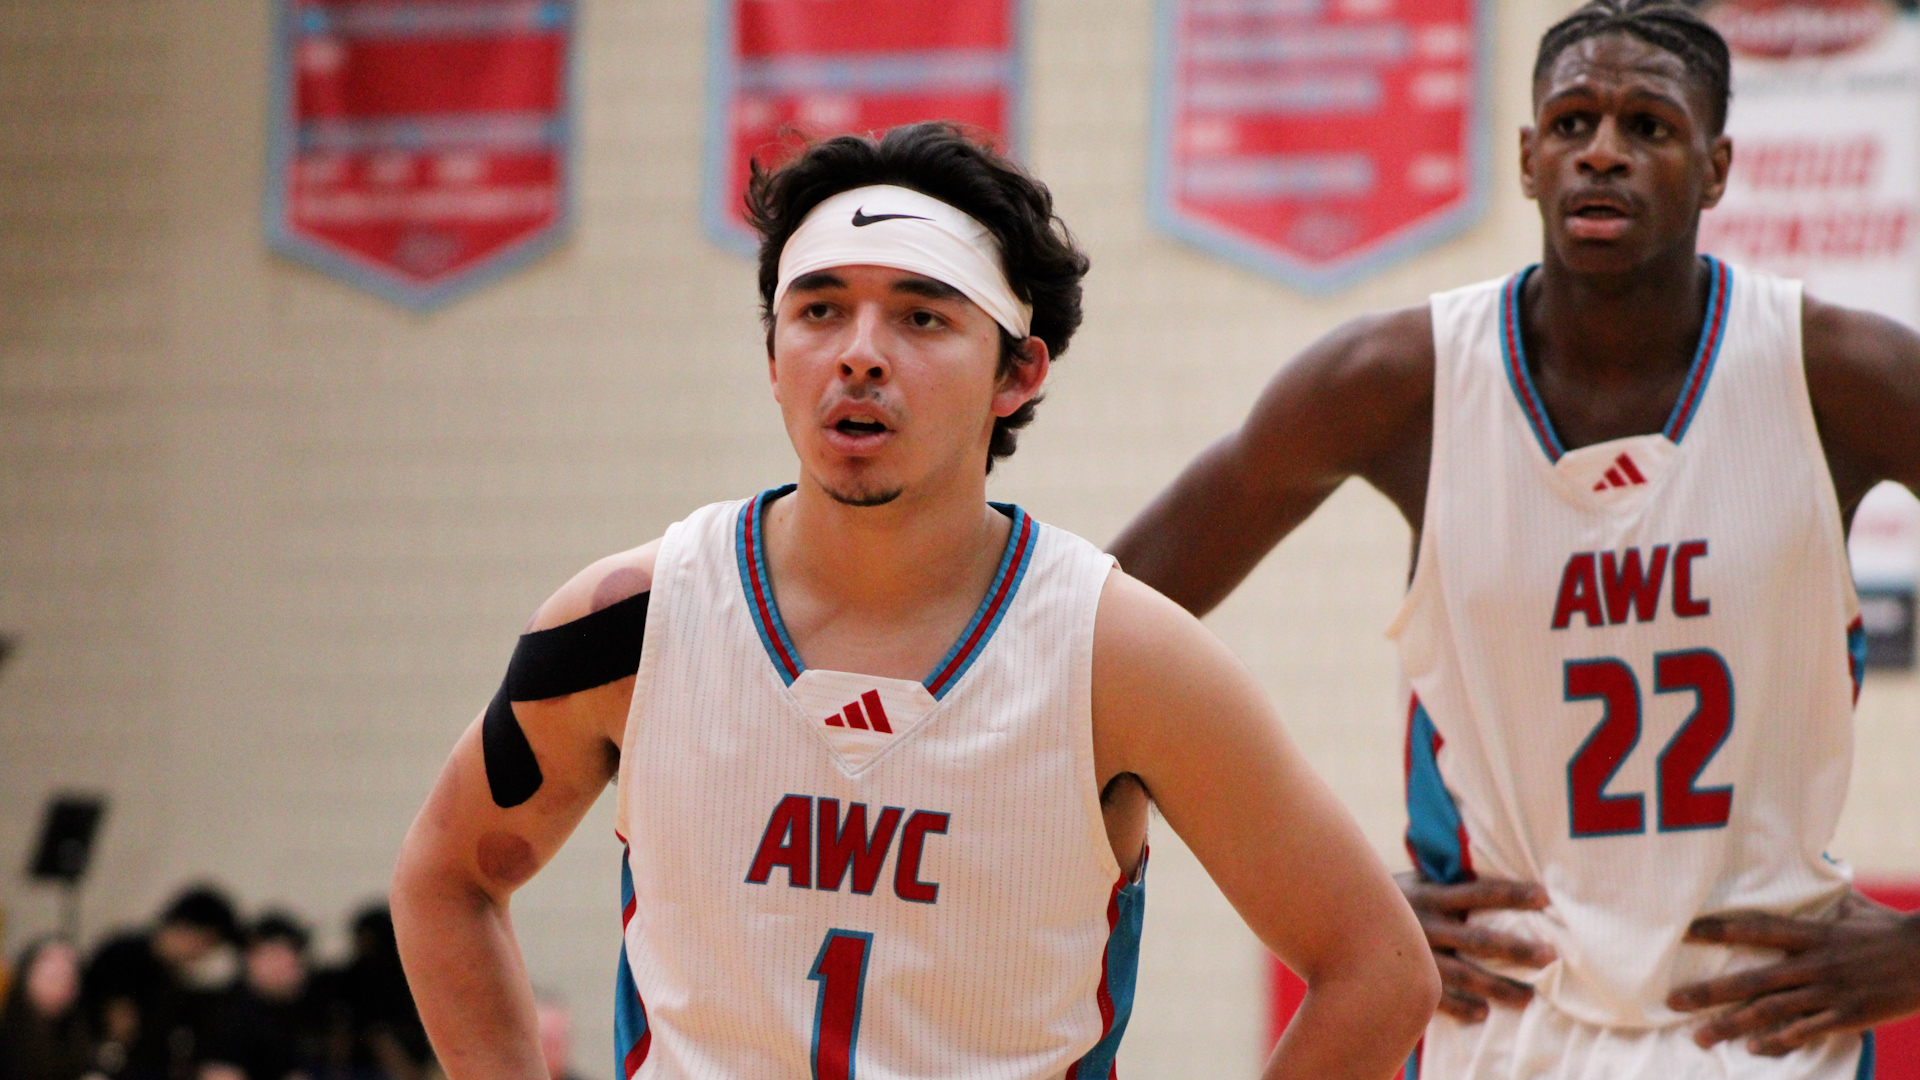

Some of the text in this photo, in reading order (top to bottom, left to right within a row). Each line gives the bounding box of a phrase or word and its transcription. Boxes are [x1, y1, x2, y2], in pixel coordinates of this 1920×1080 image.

[1551, 539, 1710, 630] AWC
[1563, 647, 1735, 839] 22
[745, 794, 950, 904] AWC
[807, 928, 874, 1080] 1
